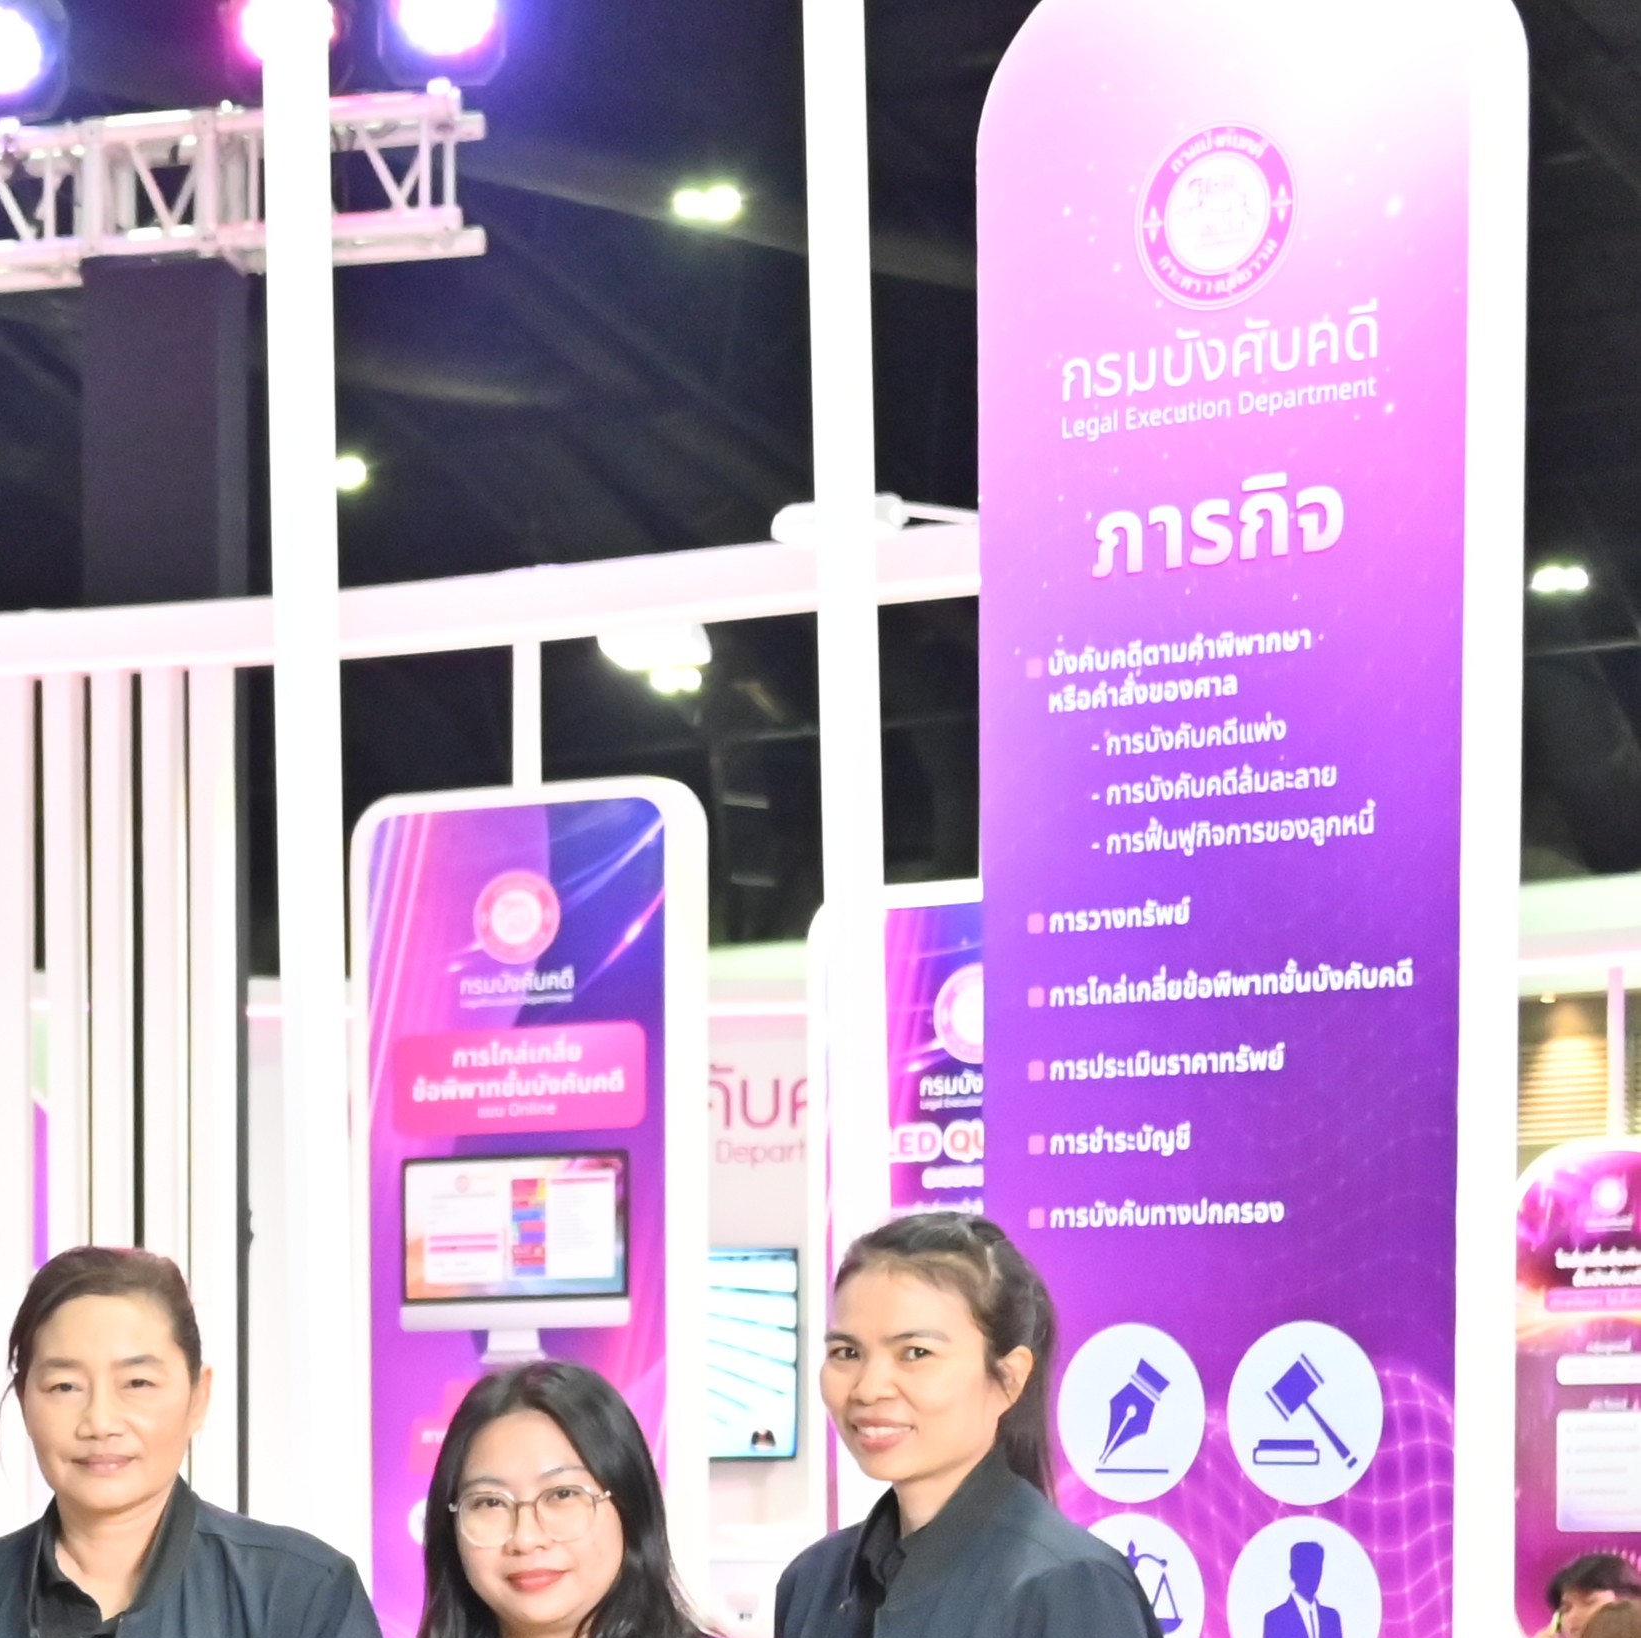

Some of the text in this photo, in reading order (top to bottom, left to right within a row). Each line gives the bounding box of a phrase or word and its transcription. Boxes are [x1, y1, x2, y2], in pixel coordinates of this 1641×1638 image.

[1062, 298, 1379, 402] กรมบังคับคดี
[1061, 376, 1377, 442] Legal Execution Department
[1091, 471, 1345, 579] ภารกิจ
[1047, 629, 1312, 676] บังคับคดีตามคำพิพากษา
[1048, 671, 1238, 713] หรือคำสั่งของศาล
[1106, 711, 1287, 756] การบังคับคดีแพ่ง
[1106, 763, 1337, 805] การบังคับคดีล้มละลาย
[1106, 798, 1376, 857] การฟื้นฟูกิจการของลูกหนี้
[1049, 895, 1191, 934] การวางทรัพย์
[1049, 956, 1414, 1008] การไกล่เกลี่ยข้อพิพาทชั้นบังคับคดี
[1049, 1041, 1286, 1082] การประเมินราคาทรัพย์
[508, 1102, 557, 1117] Online
[1049, 1120, 1192, 1157] การชำระบัญชี
[1049, 1197, 1285, 1229] การบังคับทางปกครอง
